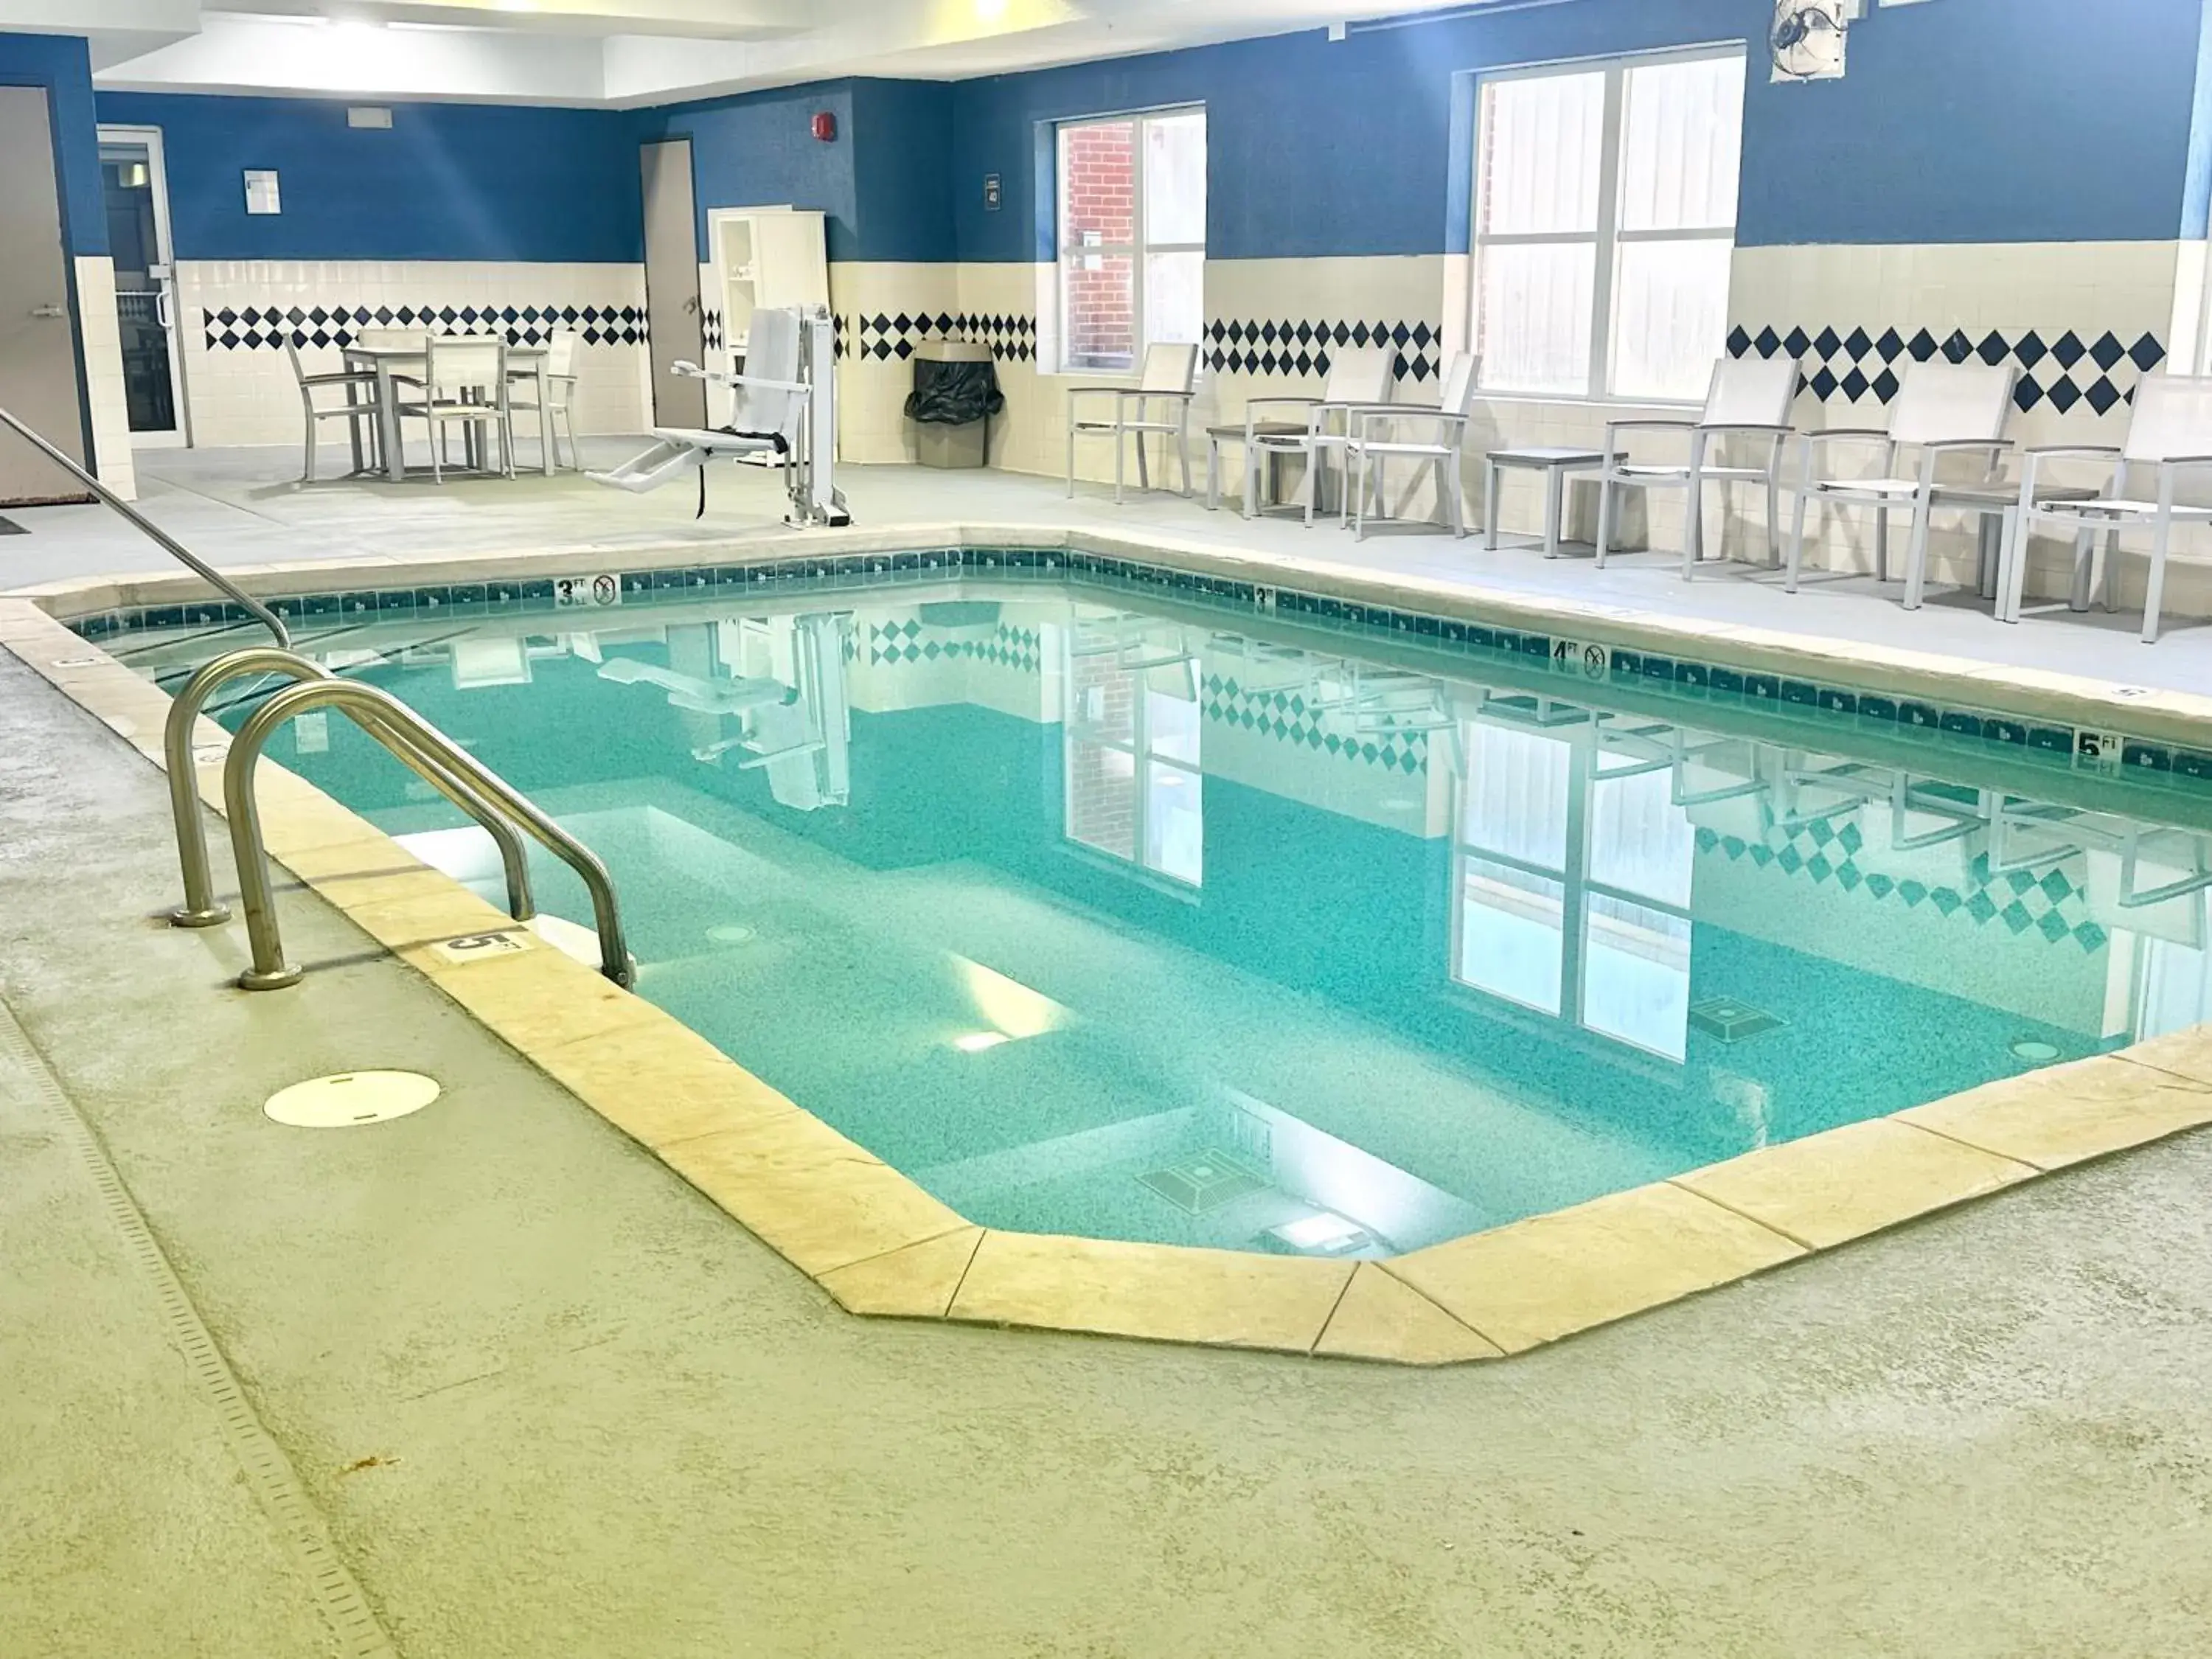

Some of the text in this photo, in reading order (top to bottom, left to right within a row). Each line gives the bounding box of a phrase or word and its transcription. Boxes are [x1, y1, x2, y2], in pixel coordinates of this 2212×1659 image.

[558, 580, 573, 598] 3
[2079, 732, 2115, 757] 5 FT
[448, 934, 510, 950] 5
